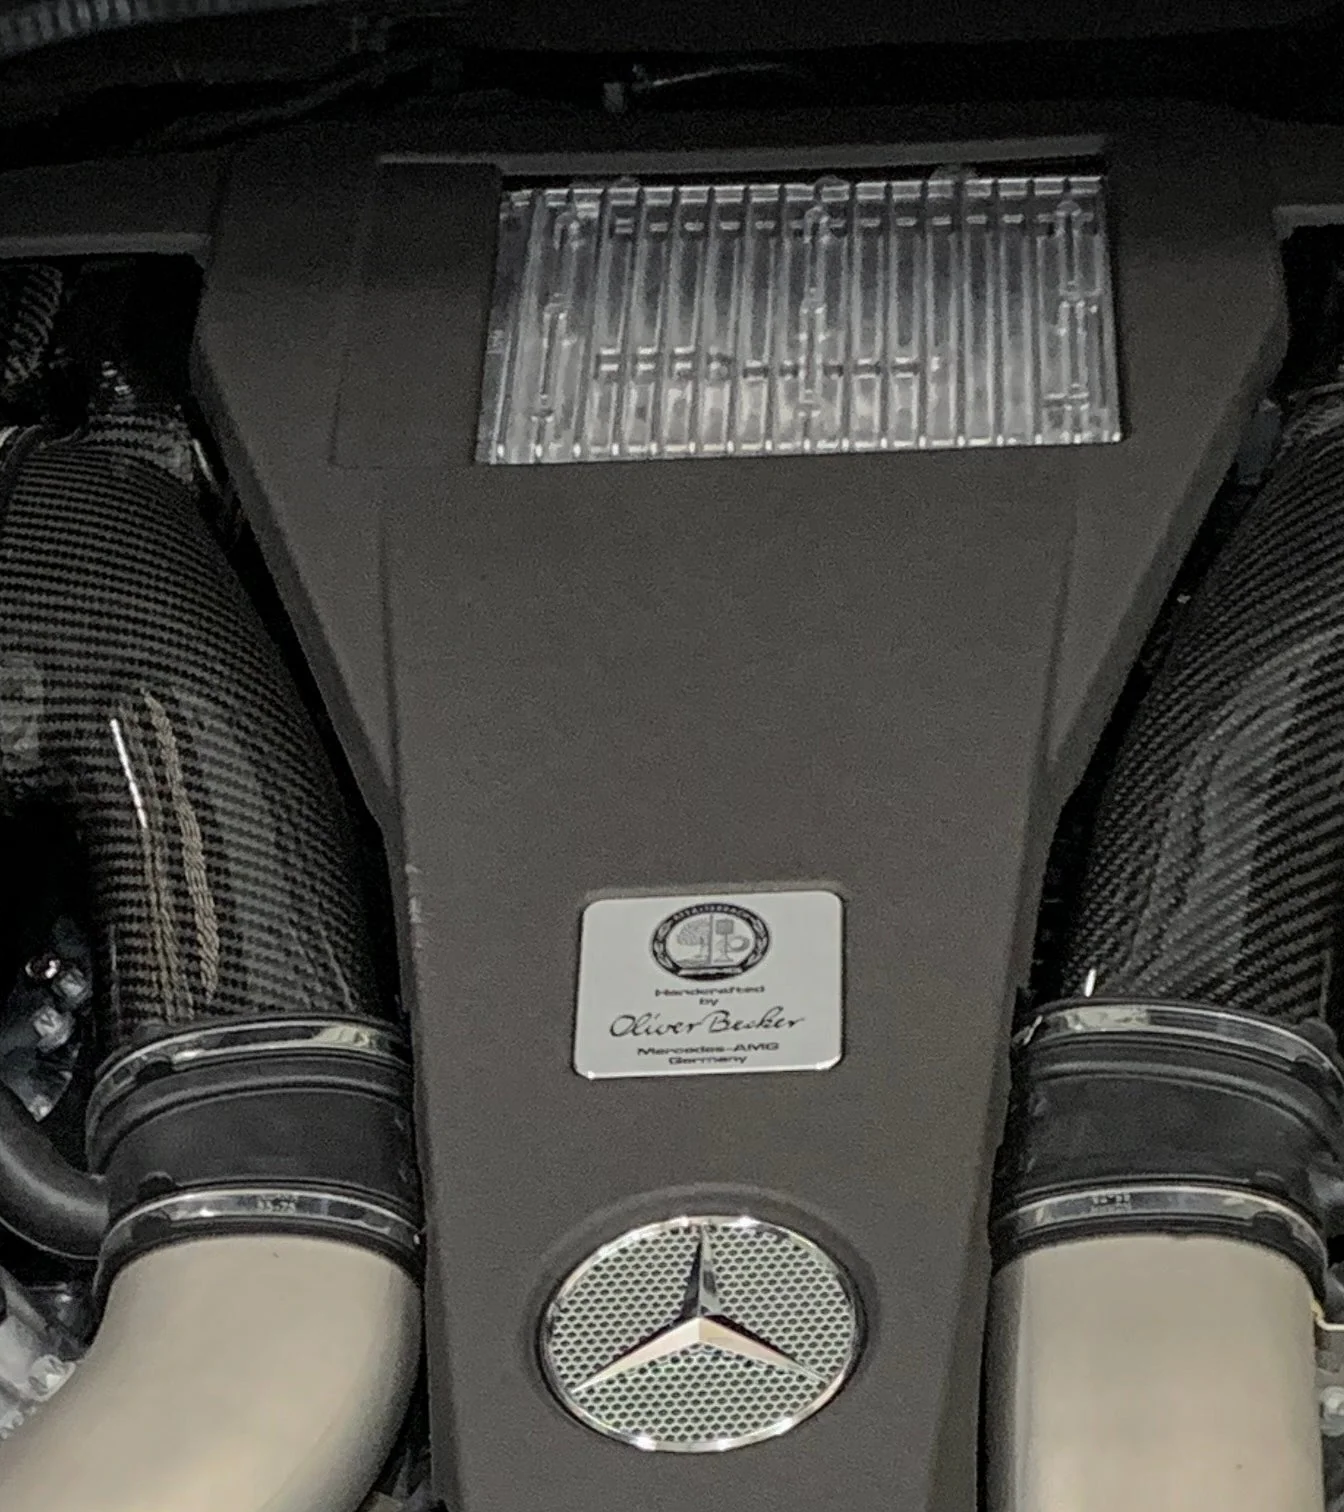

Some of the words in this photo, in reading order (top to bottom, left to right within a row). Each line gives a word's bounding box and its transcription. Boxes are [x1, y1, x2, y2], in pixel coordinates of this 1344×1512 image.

[654, 985, 765, 997] Handcrafted
[699, 997, 719, 1006] by
[609, 1012, 703, 1037] Oliver
[706, 1006, 805, 1033] Becker
[637, 1042, 779, 1056] Mercedes-AMG
[668, 1055, 748, 1065] Germany
